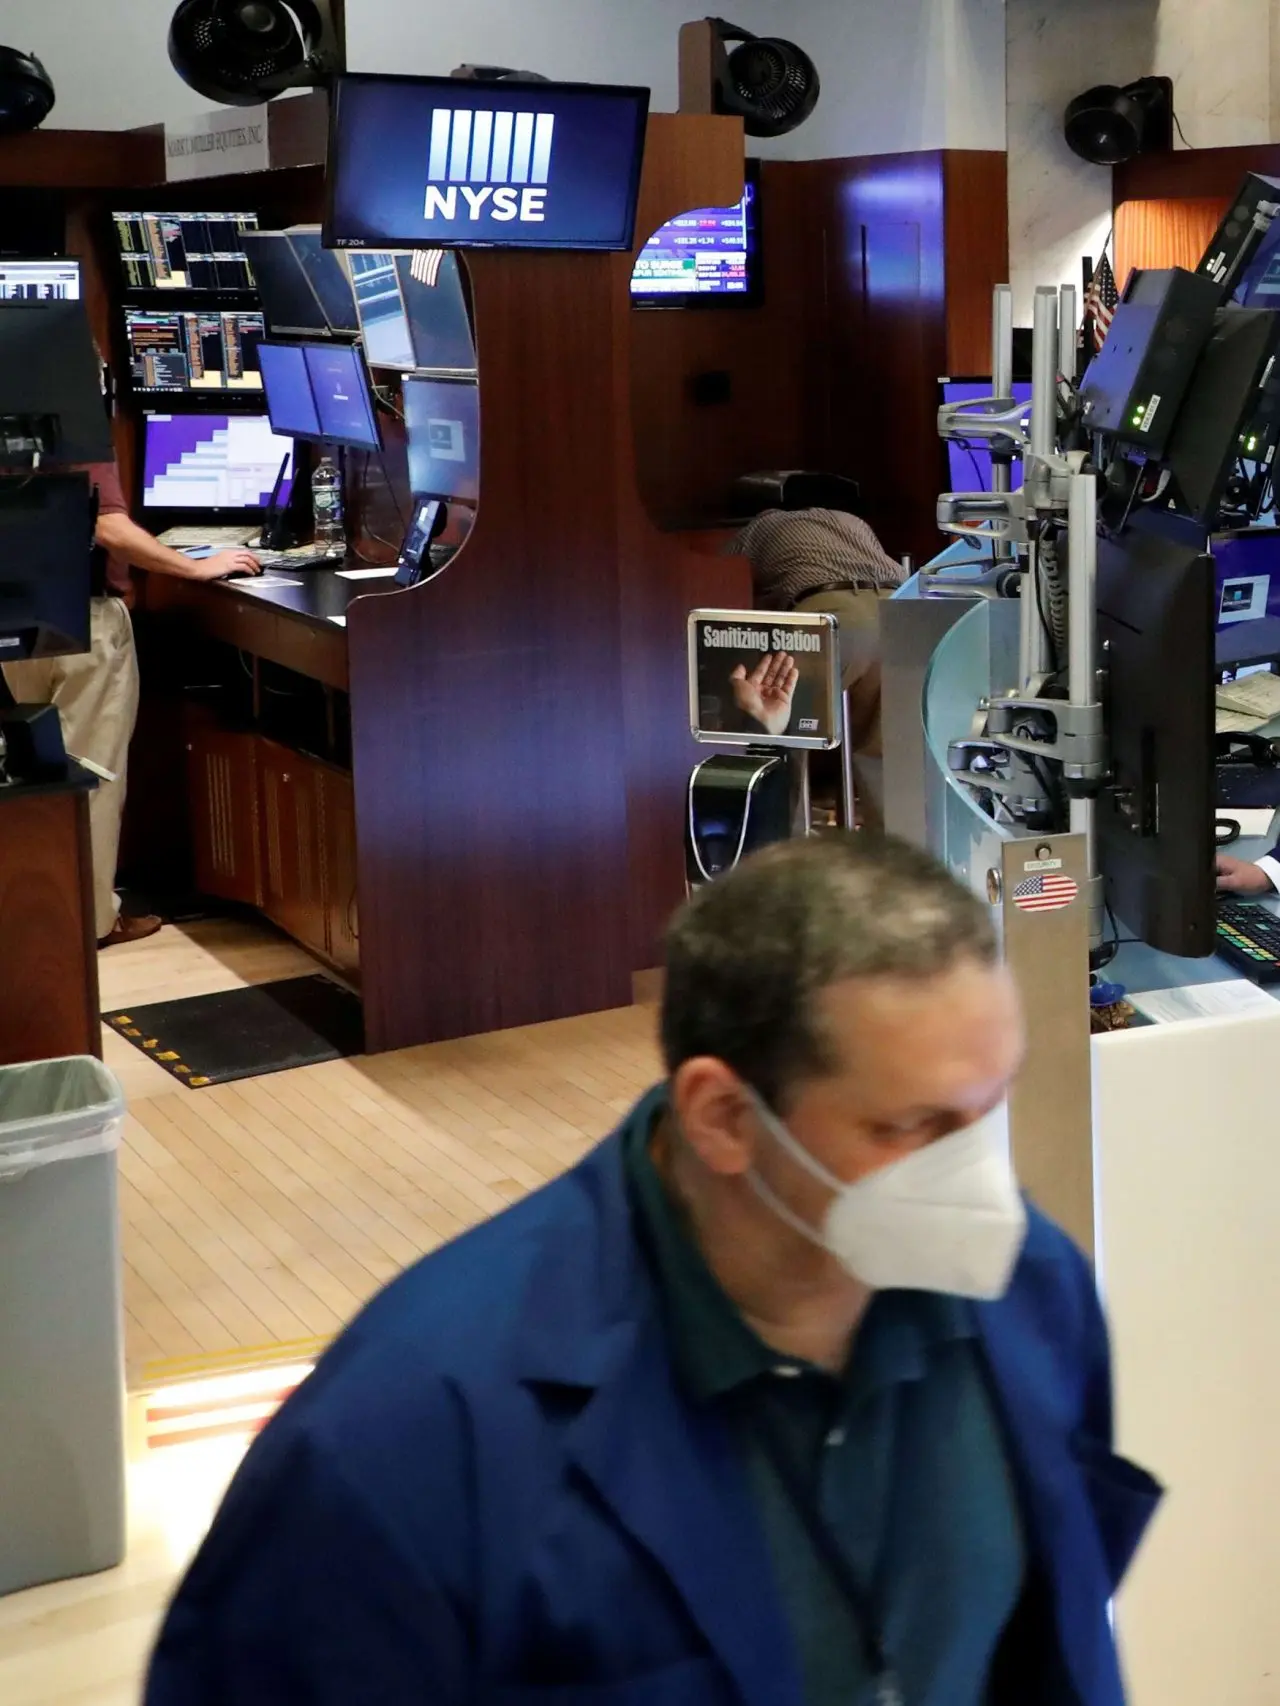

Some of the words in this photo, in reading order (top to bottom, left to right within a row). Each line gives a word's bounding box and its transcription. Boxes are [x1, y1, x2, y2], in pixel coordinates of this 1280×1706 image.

[423, 185, 548, 222] NYSE
[703, 625, 769, 652] Sanitizing
[772, 628, 821, 652] Station
